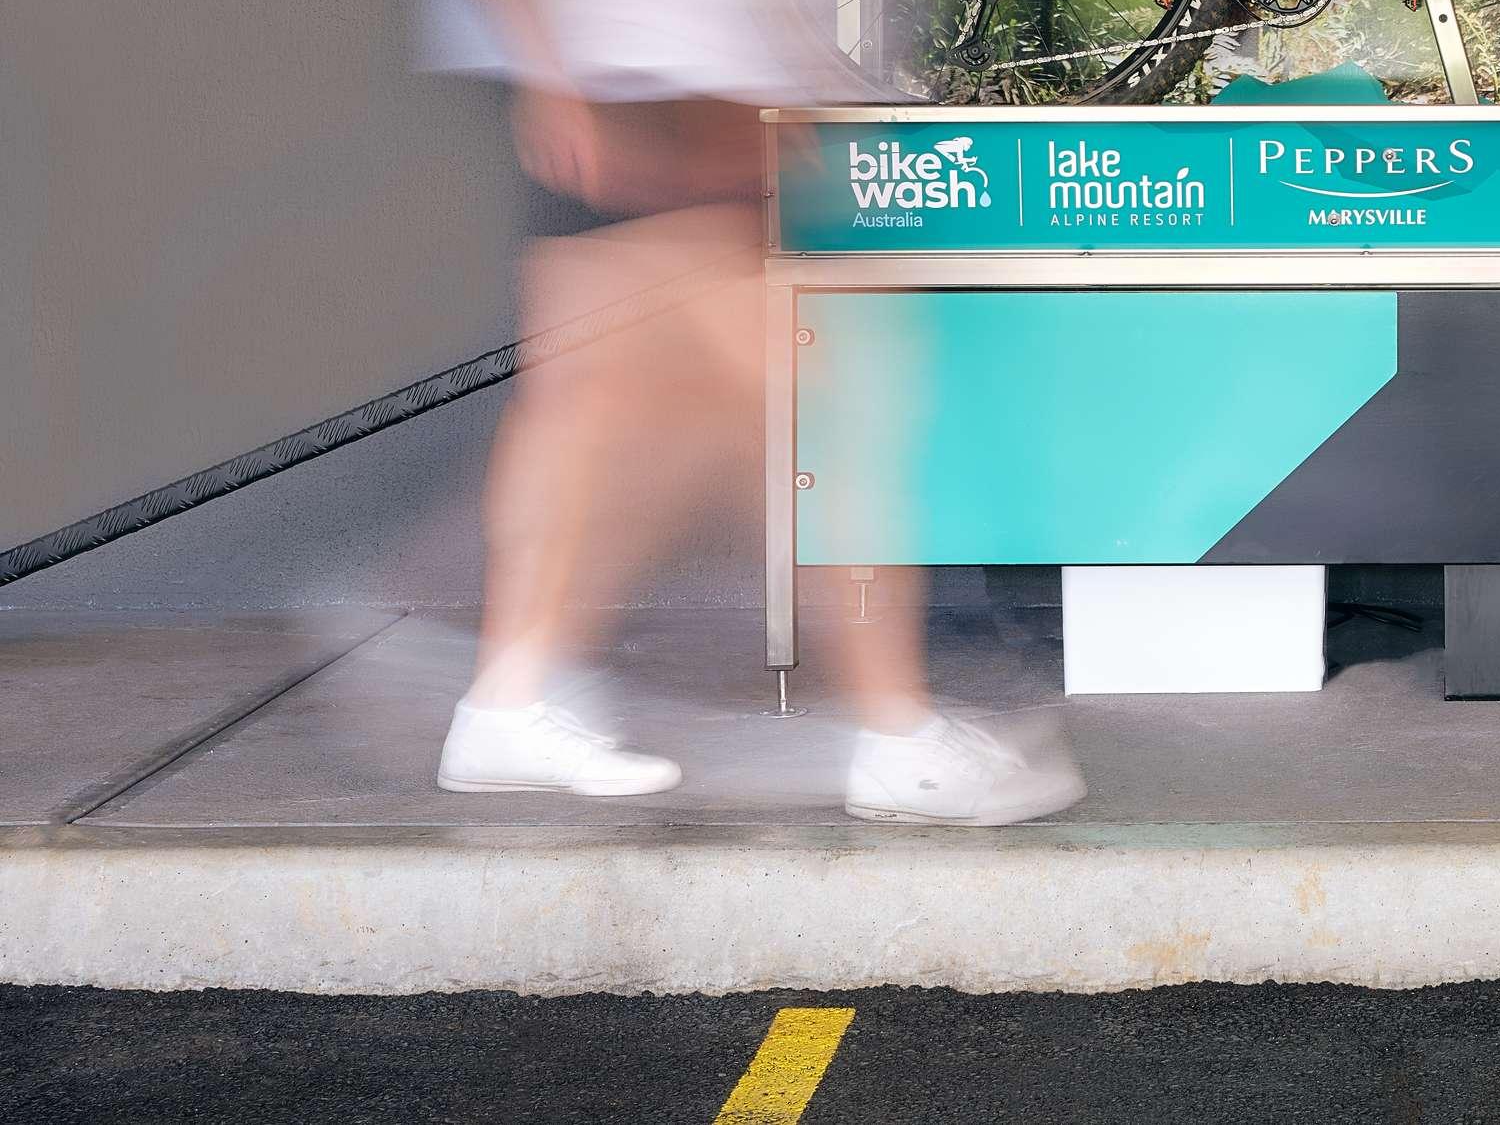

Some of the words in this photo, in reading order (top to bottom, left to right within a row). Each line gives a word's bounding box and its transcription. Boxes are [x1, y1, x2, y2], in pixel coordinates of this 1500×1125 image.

[849, 141, 942, 180] bike
[1049, 140, 1121, 178] lake
[850, 169, 976, 209] wash
[1049, 167, 1205, 209] mountain
[852, 212, 923, 228] Australia
[1050, 213, 1120, 226] ALPINE
[1130, 213, 1205, 226] RESORT
